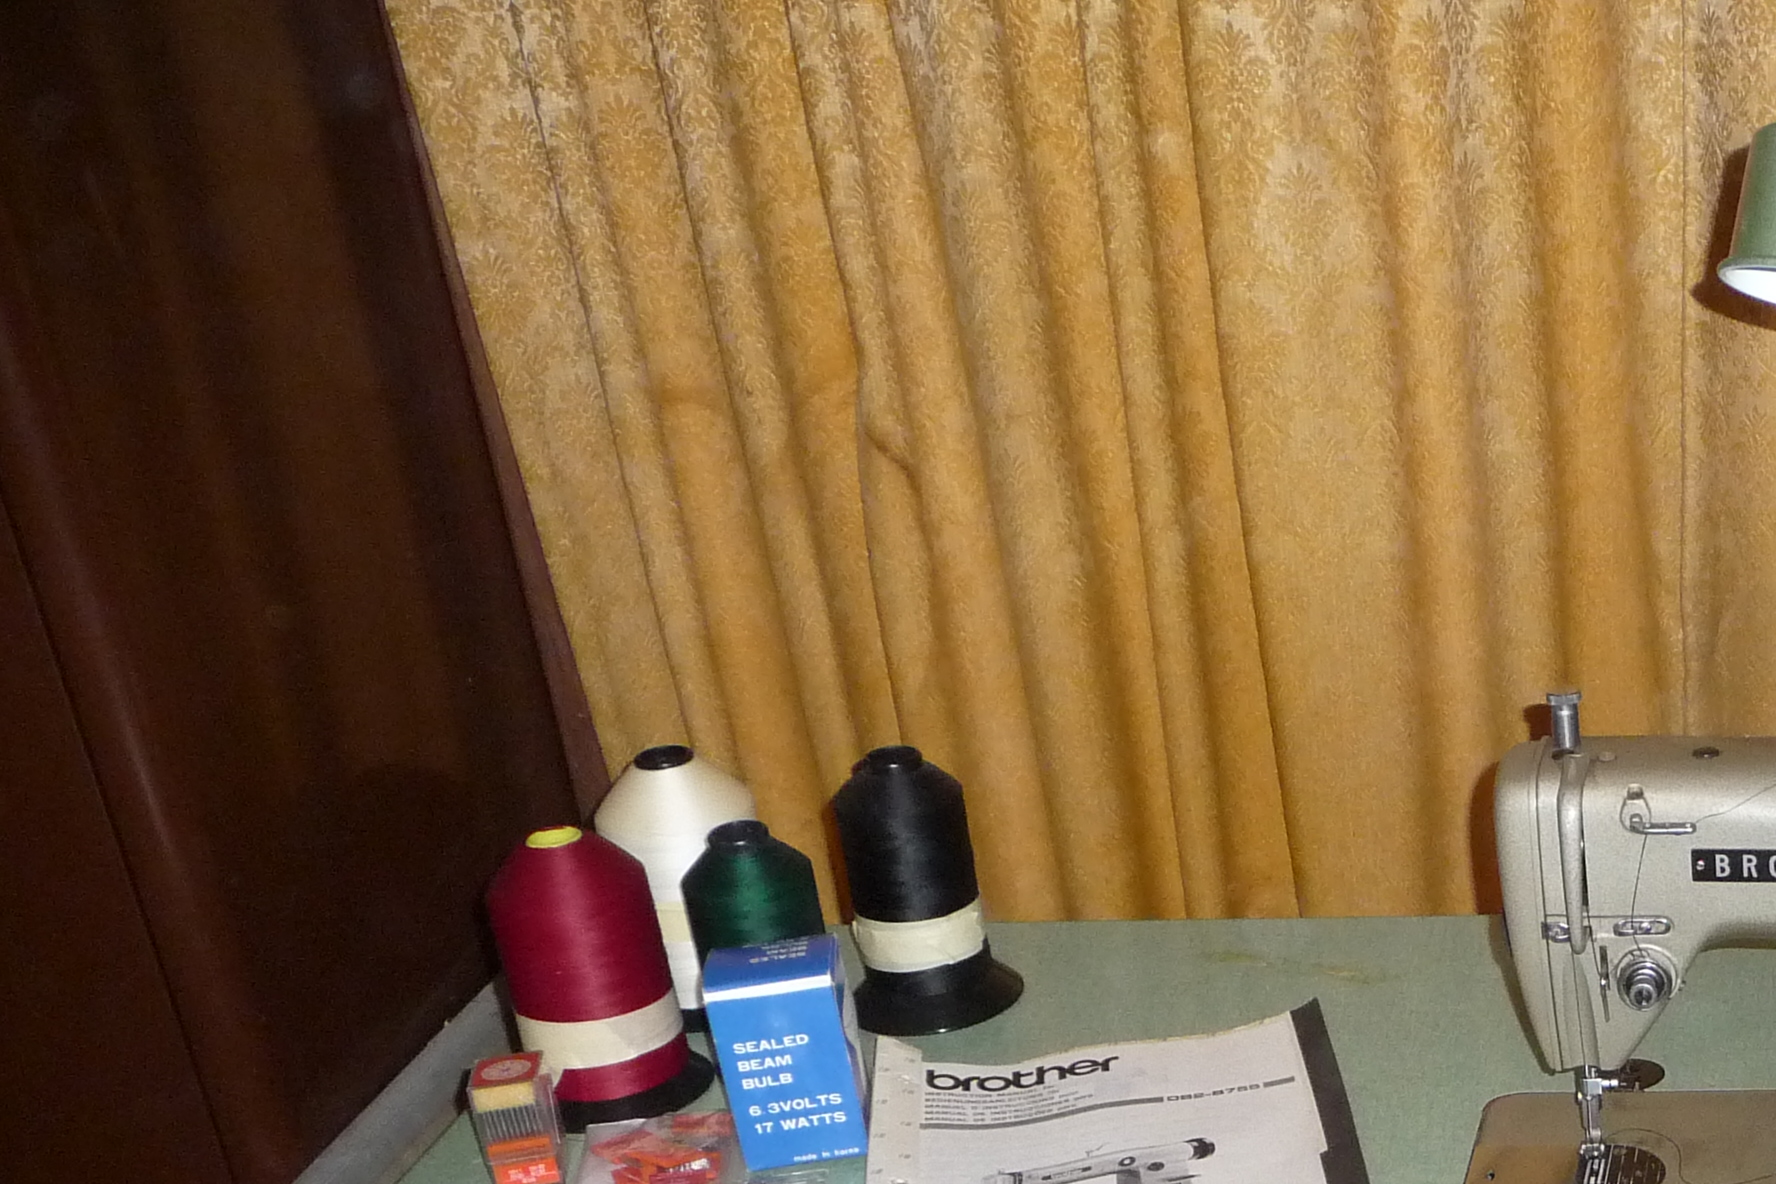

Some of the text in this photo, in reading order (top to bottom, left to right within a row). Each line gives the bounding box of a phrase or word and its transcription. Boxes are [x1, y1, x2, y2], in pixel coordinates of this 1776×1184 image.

[732, 1033, 809, 1054] SEALED
[737, 1054, 793, 1072] BEAM
[741, 1073, 794, 1090] BULB
[926, 1056, 1120, 1092] brother
[754, 1111, 847, 1135] 17 WATTS
